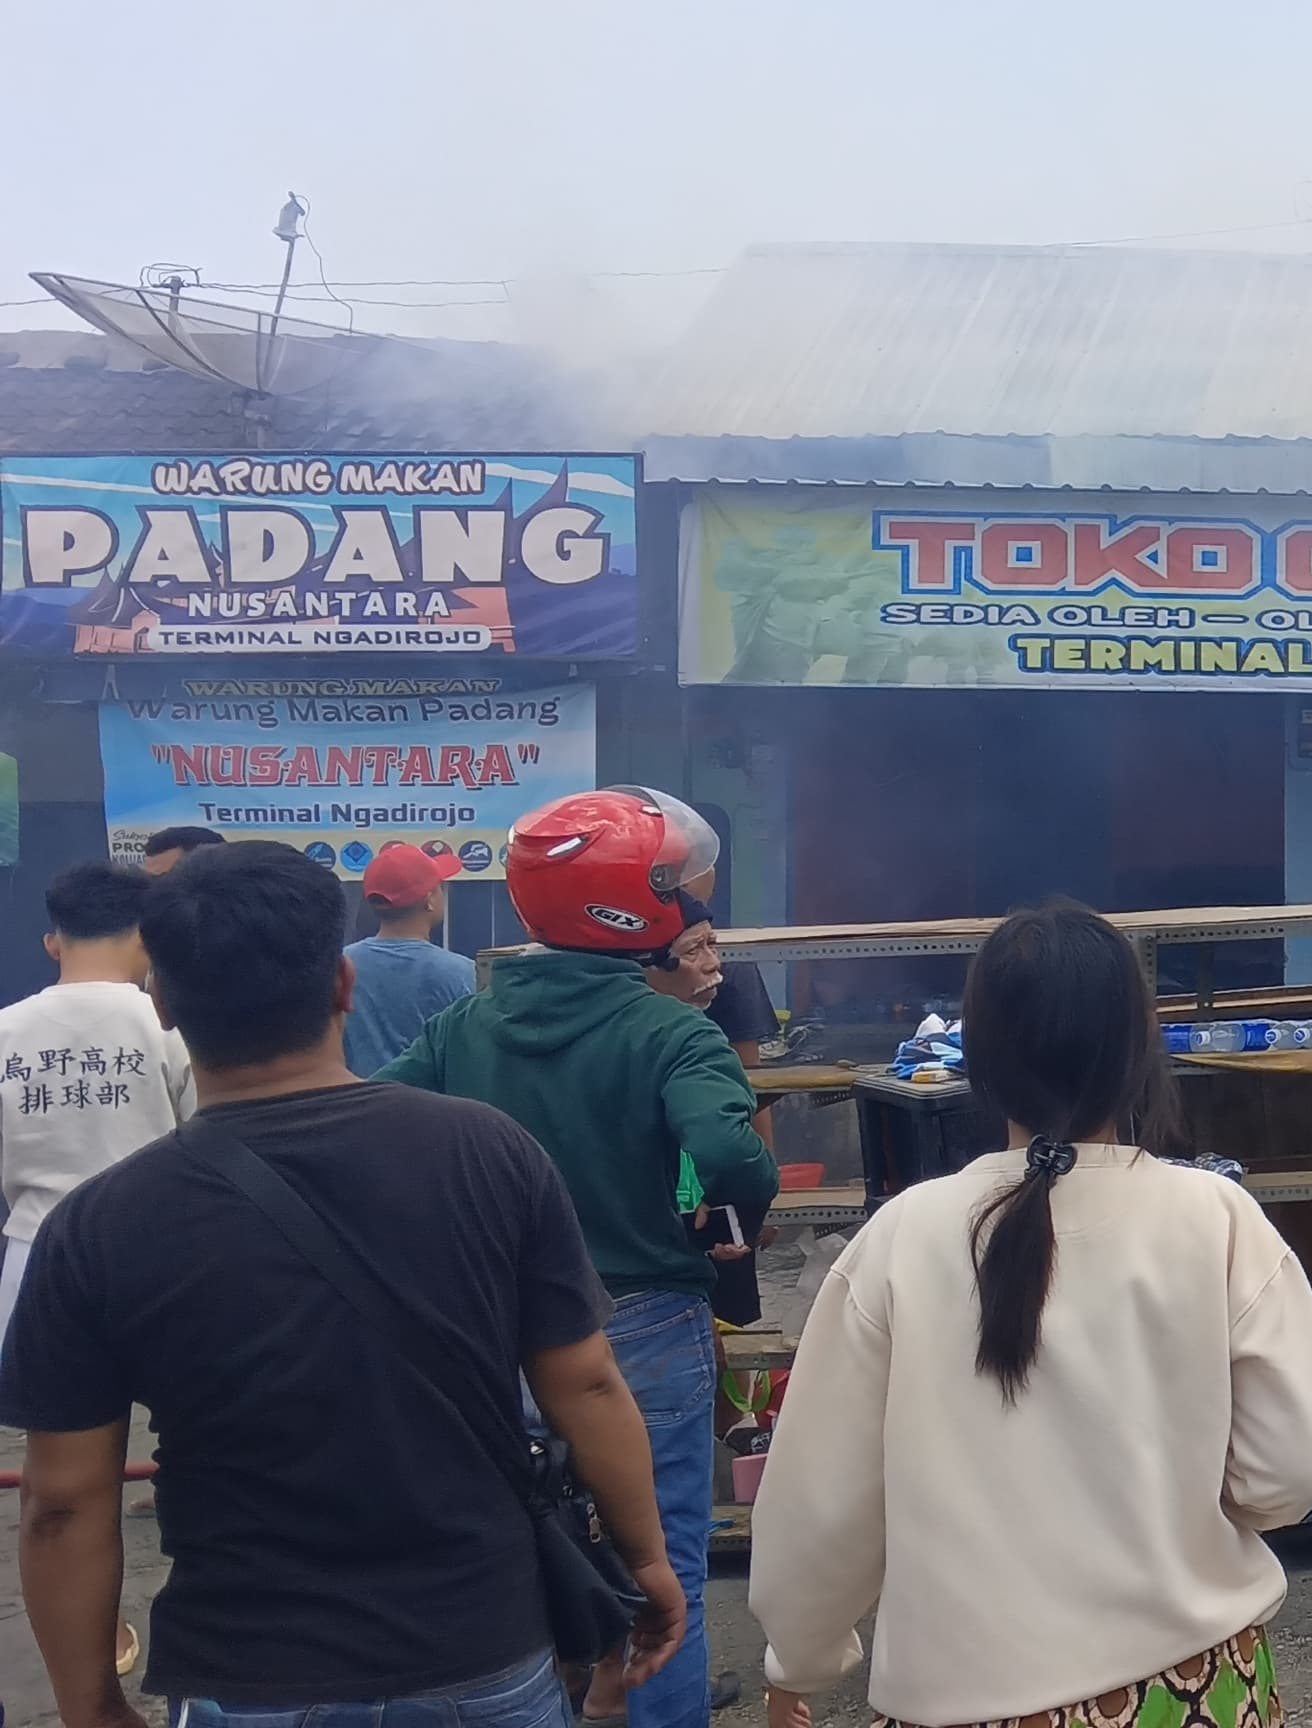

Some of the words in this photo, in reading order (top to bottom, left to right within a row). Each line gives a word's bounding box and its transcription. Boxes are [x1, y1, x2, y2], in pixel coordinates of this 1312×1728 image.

[153, 459, 332, 495] WARUNG
[338, 461, 485, 495] MAKAN
[21, 505, 611, 586] PADANG
[880, 515, 1258, 594] TOKO
[187, 591, 450, 618] NUSANTARA
[883, 603, 1040, 626] SEDIA
[1050, 604, 1193, 627] OLEH
[159, 630, 303, 646] TERMINAL
[313, 630, 483, 646] NGADIROJO
[186, 679, 346, 697] WARUNG
[353, 678, 500, 697] MAKAN
[127, 698, 280, 729] Warung
[287, 699, 408, 723] Makan
[421, 697, 561, 726] Padang
[198, 803, 321, 825] Terminal
[330, 803, 476, 829] Ngadirojo
[18, 1079, 131, 1115] 排球部
